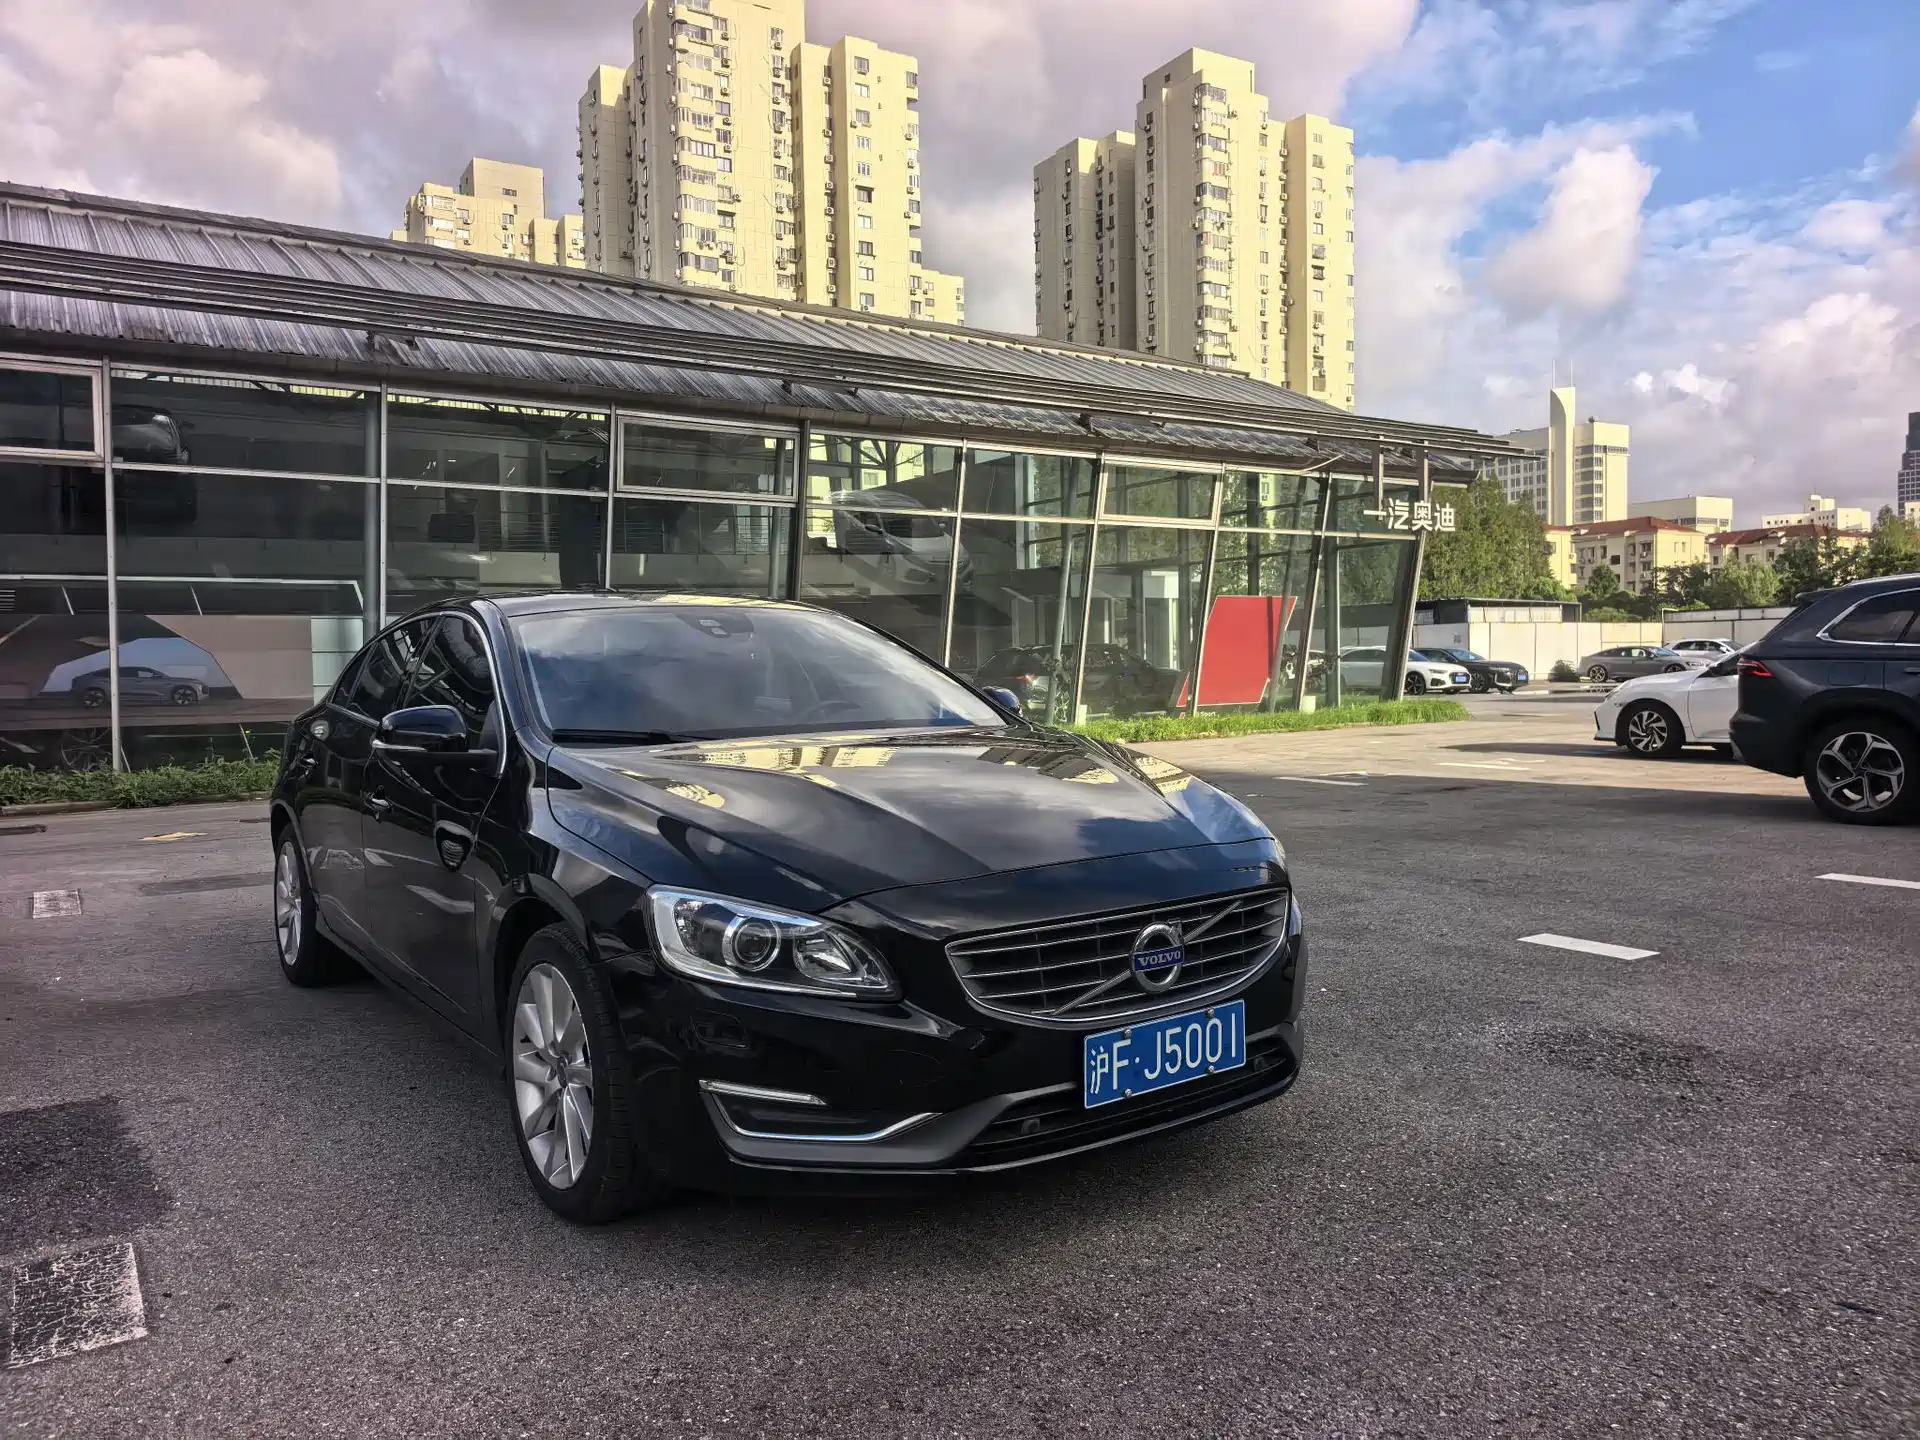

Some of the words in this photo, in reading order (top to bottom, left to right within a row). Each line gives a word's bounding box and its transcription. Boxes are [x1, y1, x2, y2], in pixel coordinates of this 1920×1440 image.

[1363, 498, 1456, 532] 一汽奥迪
[1138, 950, 1181, 967] VOLVO
